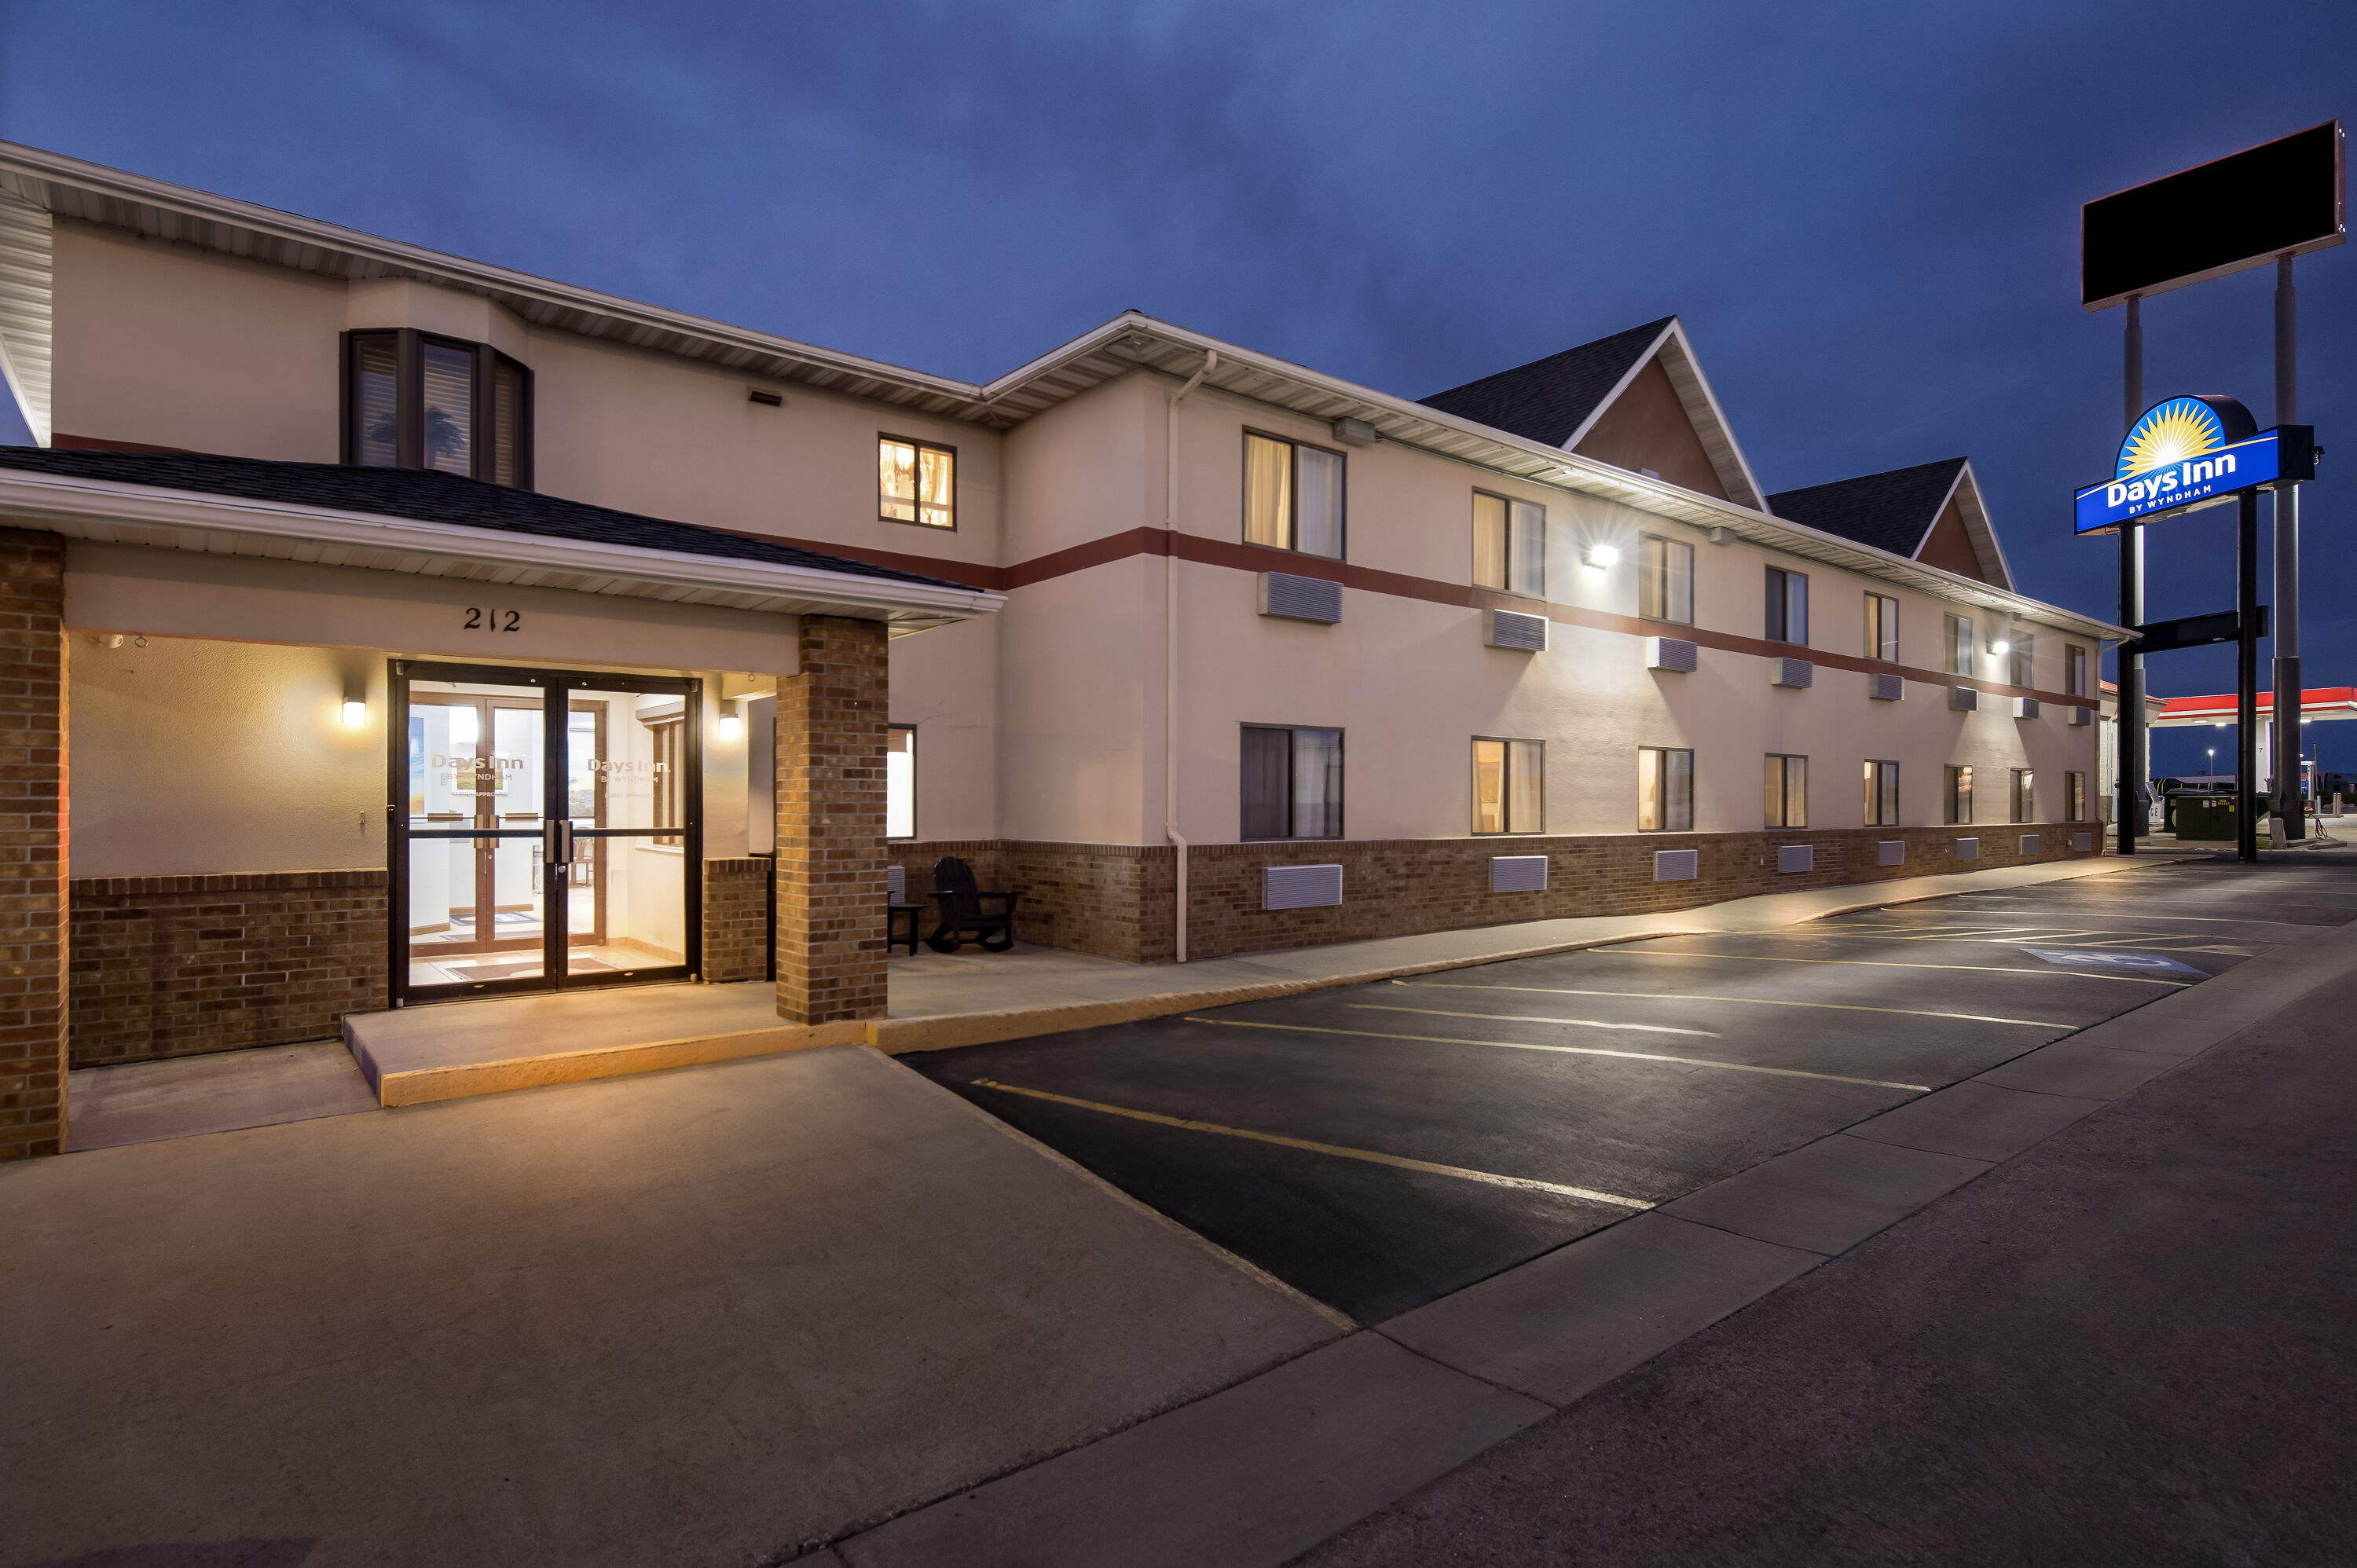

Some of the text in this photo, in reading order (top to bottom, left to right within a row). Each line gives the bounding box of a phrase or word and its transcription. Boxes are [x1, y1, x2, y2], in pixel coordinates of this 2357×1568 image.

[2108, 453, 2236, 507] Days Inn
[2128, 484, 2212, 515] BY WYNDHAM
[464, 607, 520, 632] 212
[431, 754, 524, 770] Days Inn
[588, 758, 635, 773] Days
[2150, 807, 2158, 817] CE
